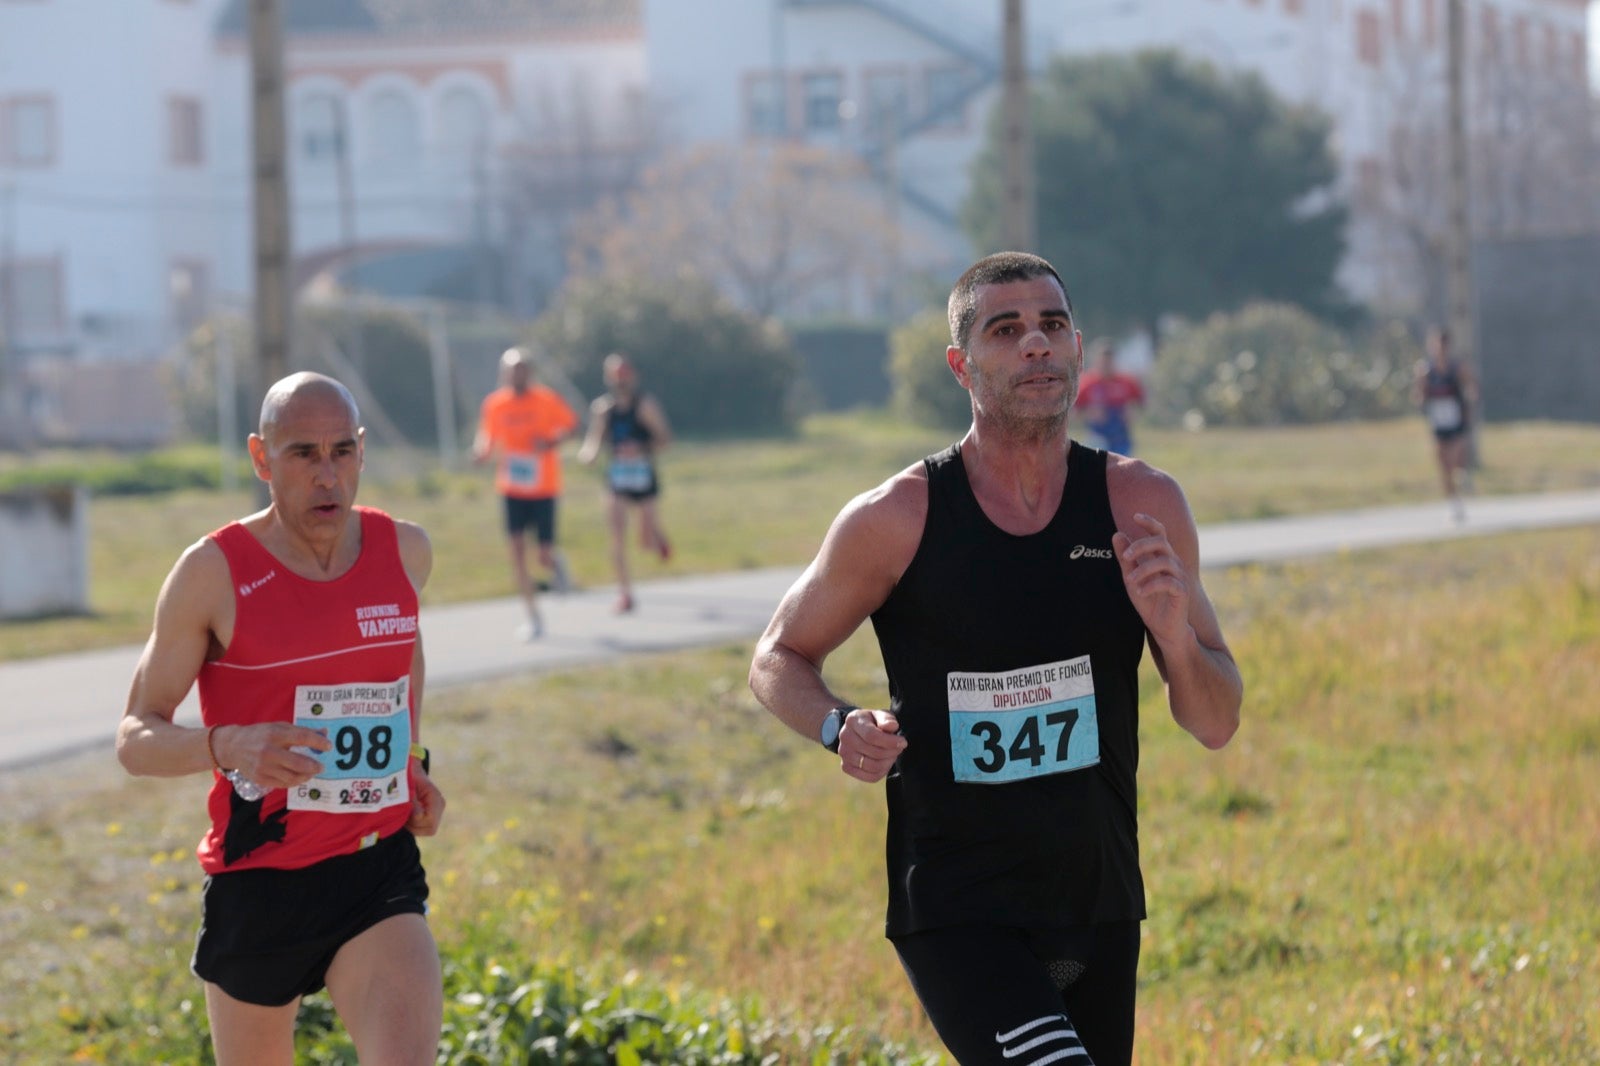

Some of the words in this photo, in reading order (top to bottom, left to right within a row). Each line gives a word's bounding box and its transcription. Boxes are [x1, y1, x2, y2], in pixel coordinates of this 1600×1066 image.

[356, 603, 400, 620] RUNNING
[358, 615, 416, 638] VAMPIROS
[950, 677, 976, 692] XXXIII
[978, 677, 1004, 692] GRAN
[1006, 671, 1043, 690] PREMIO
[1044, 668, 1056, 683] DE
[333, 688, 352, 702] GRAN
[354, 687, 387, 701] PREMIO
[993, 684, 1052, 708] DIPUTACIÓN
[335, 725, 392, 770] 98
[970, 708, 1079, 774] 347
